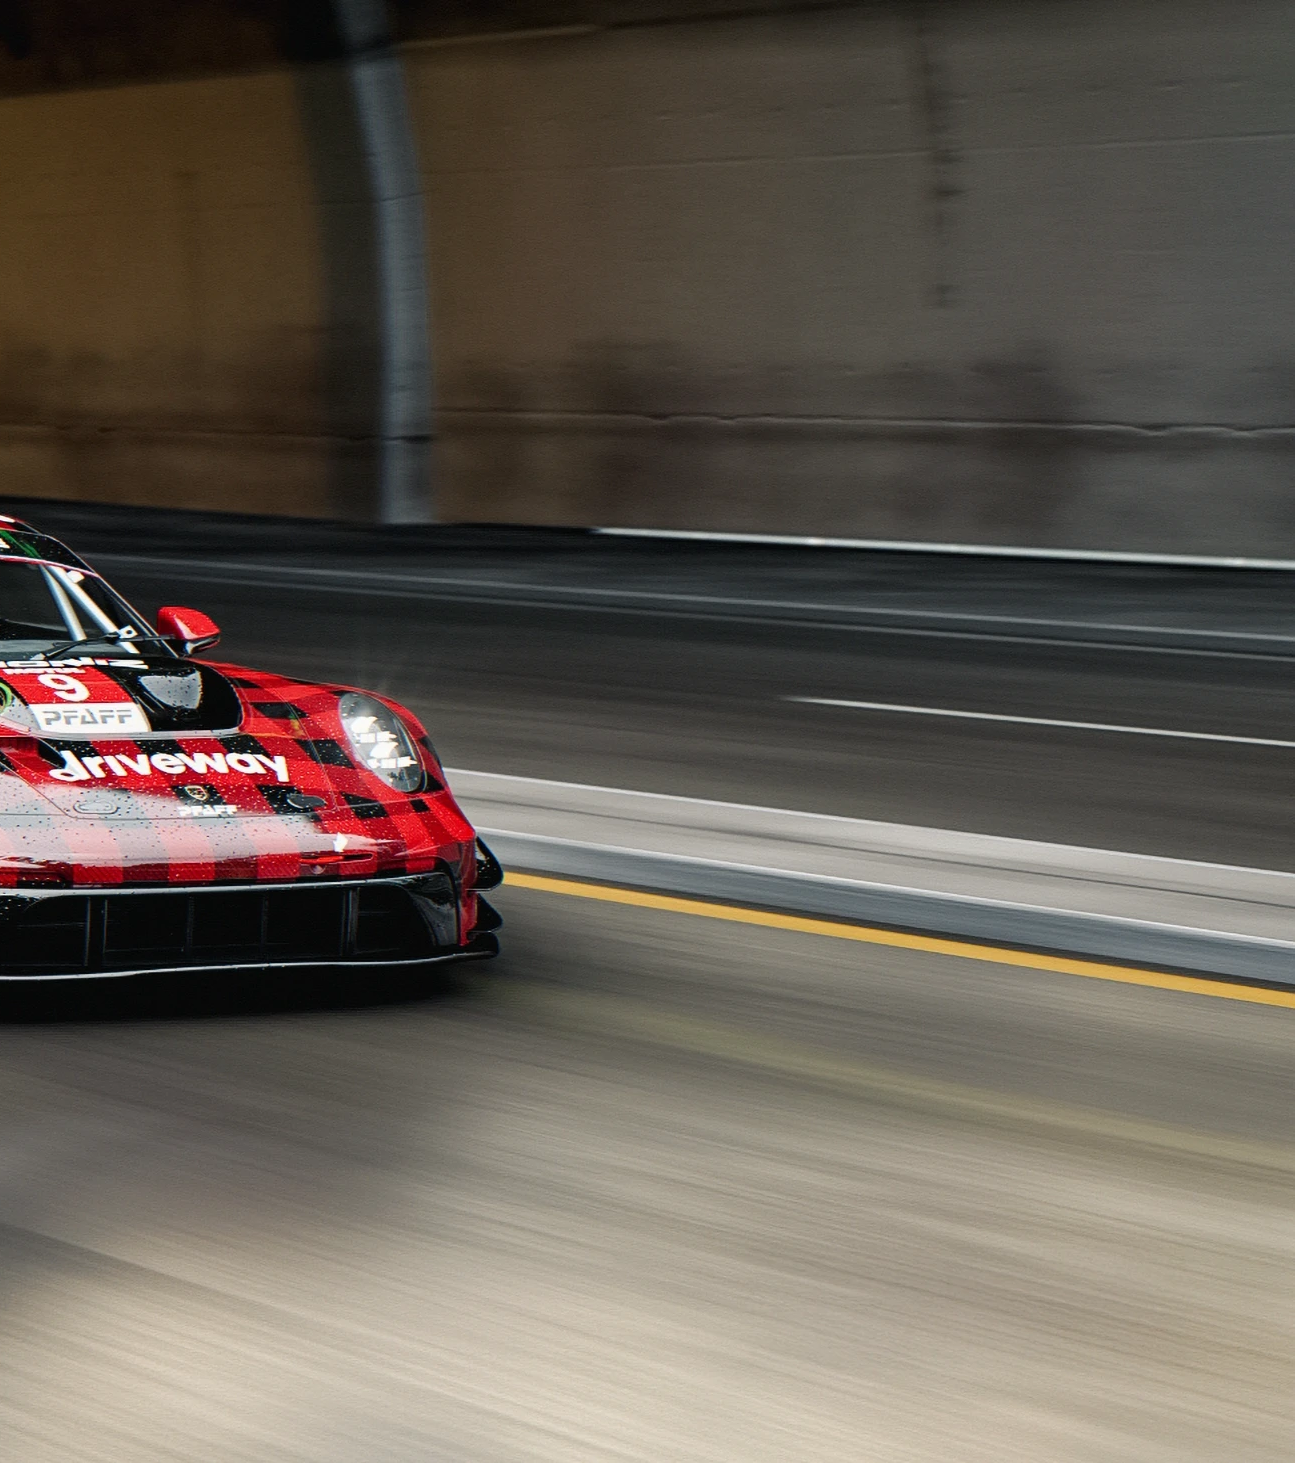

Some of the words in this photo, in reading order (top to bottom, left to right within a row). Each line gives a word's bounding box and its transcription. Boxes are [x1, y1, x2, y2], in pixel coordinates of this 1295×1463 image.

[37, 674, 90, 702] 9
[40, 709, 132, 726] PFAFF
[49, 750, 289, 782] driveway
[177, 804, 237, 817] PFAFF
